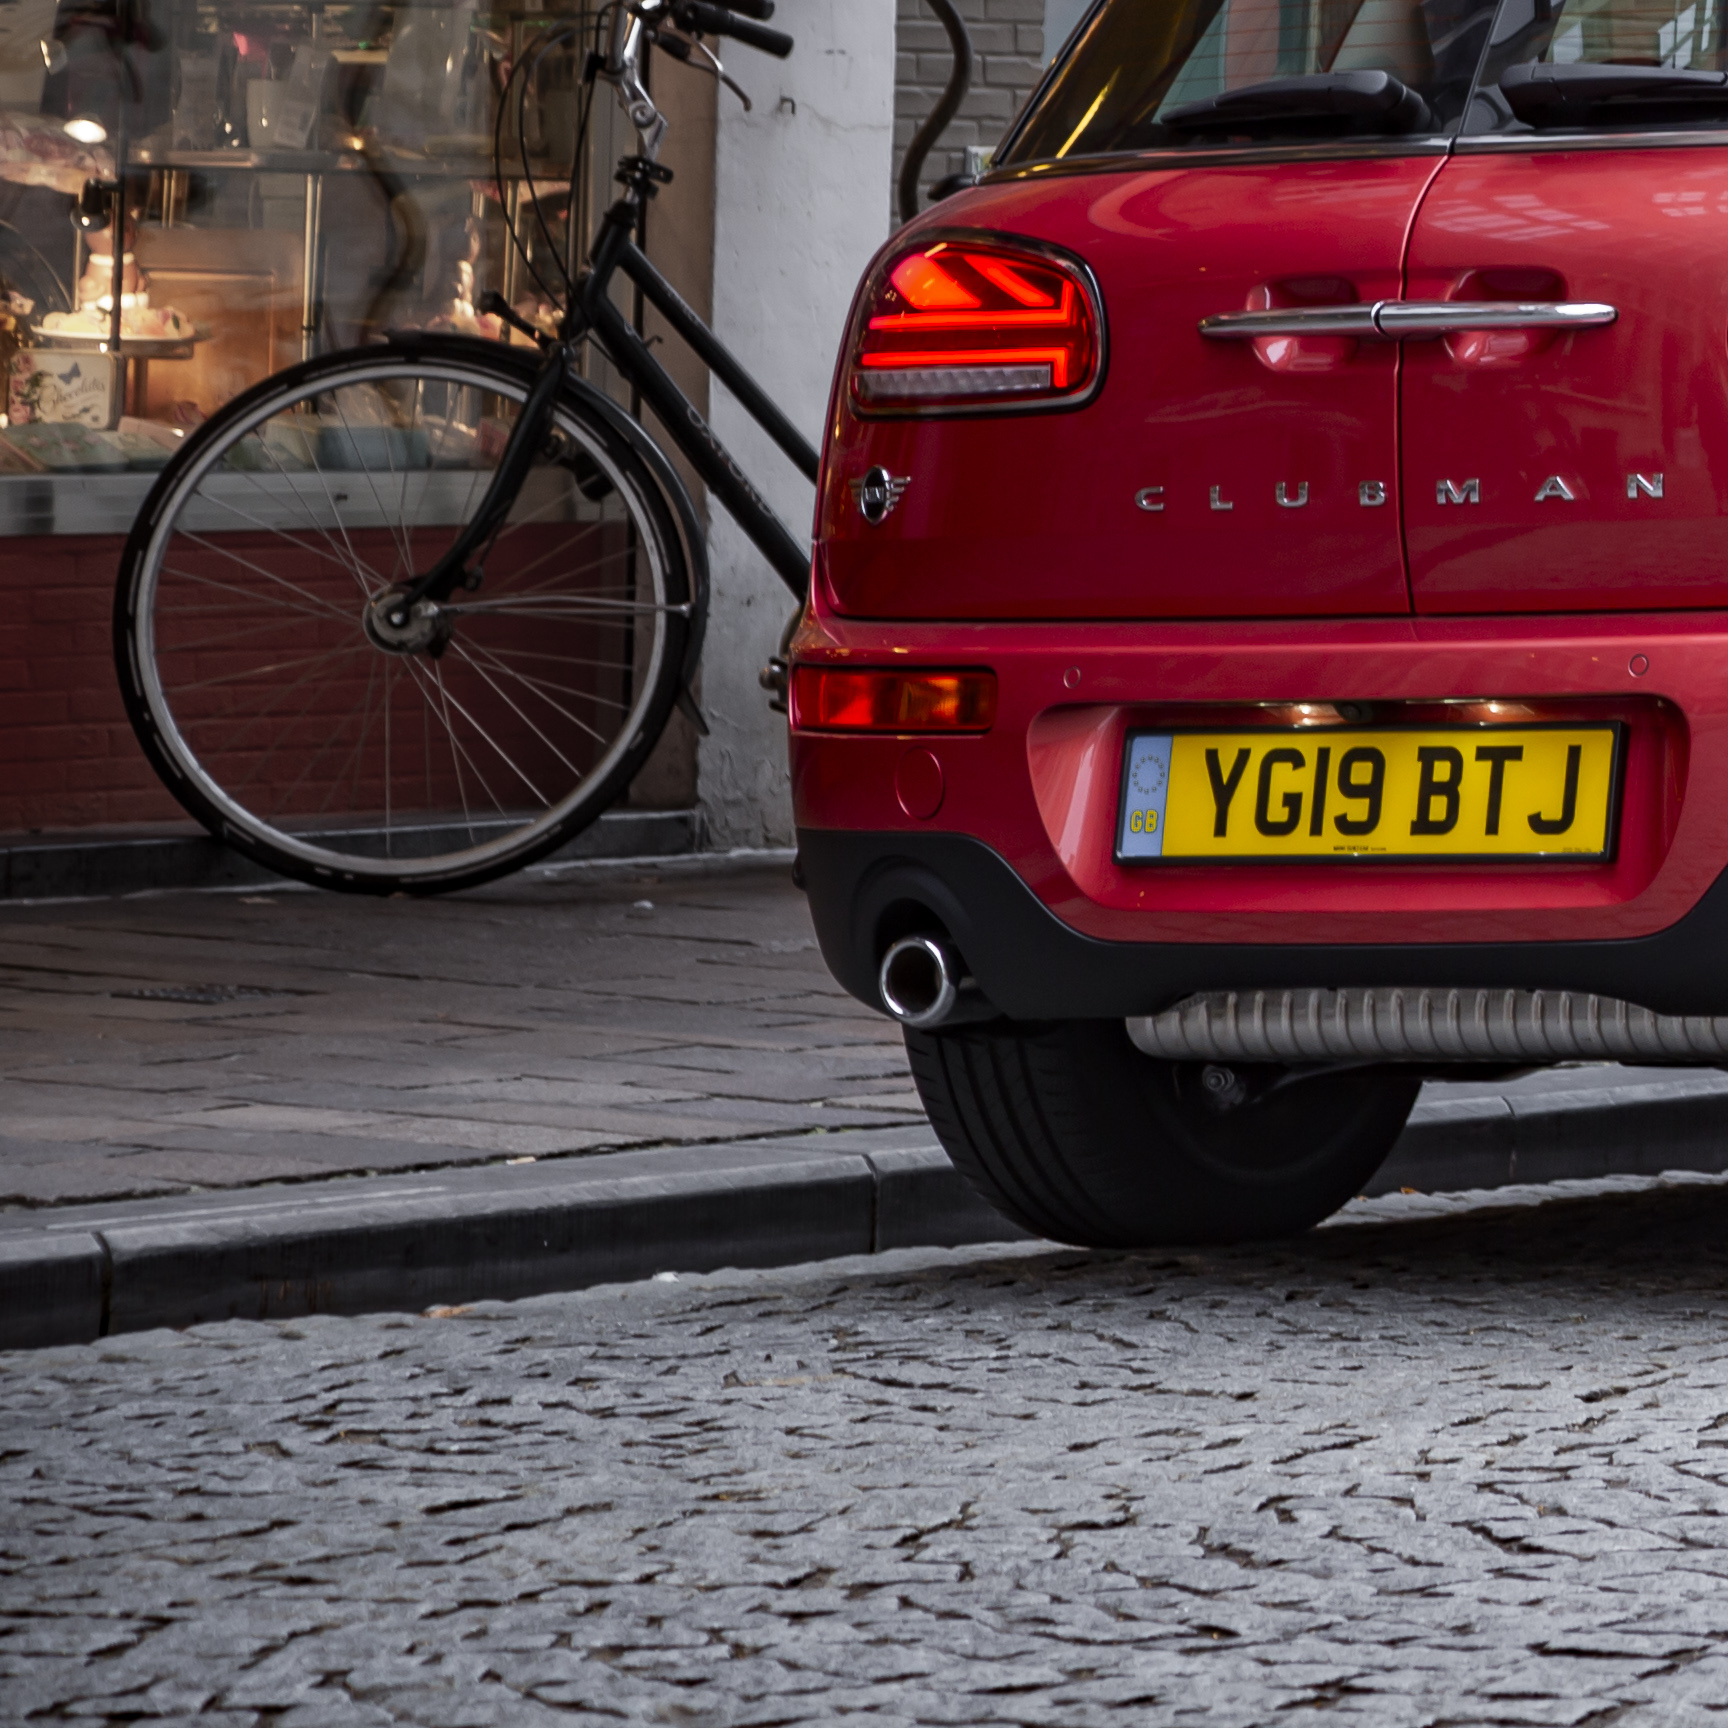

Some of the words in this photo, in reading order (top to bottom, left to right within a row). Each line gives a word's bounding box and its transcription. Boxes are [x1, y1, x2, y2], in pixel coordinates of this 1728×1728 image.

[1134, 472, 1665, 512] CLUBMAN
[1204, 745, 1387, 838] YG19
[1409, 744, 1583, 837] BTJ
[1130, 809, 1159, 834] GB
